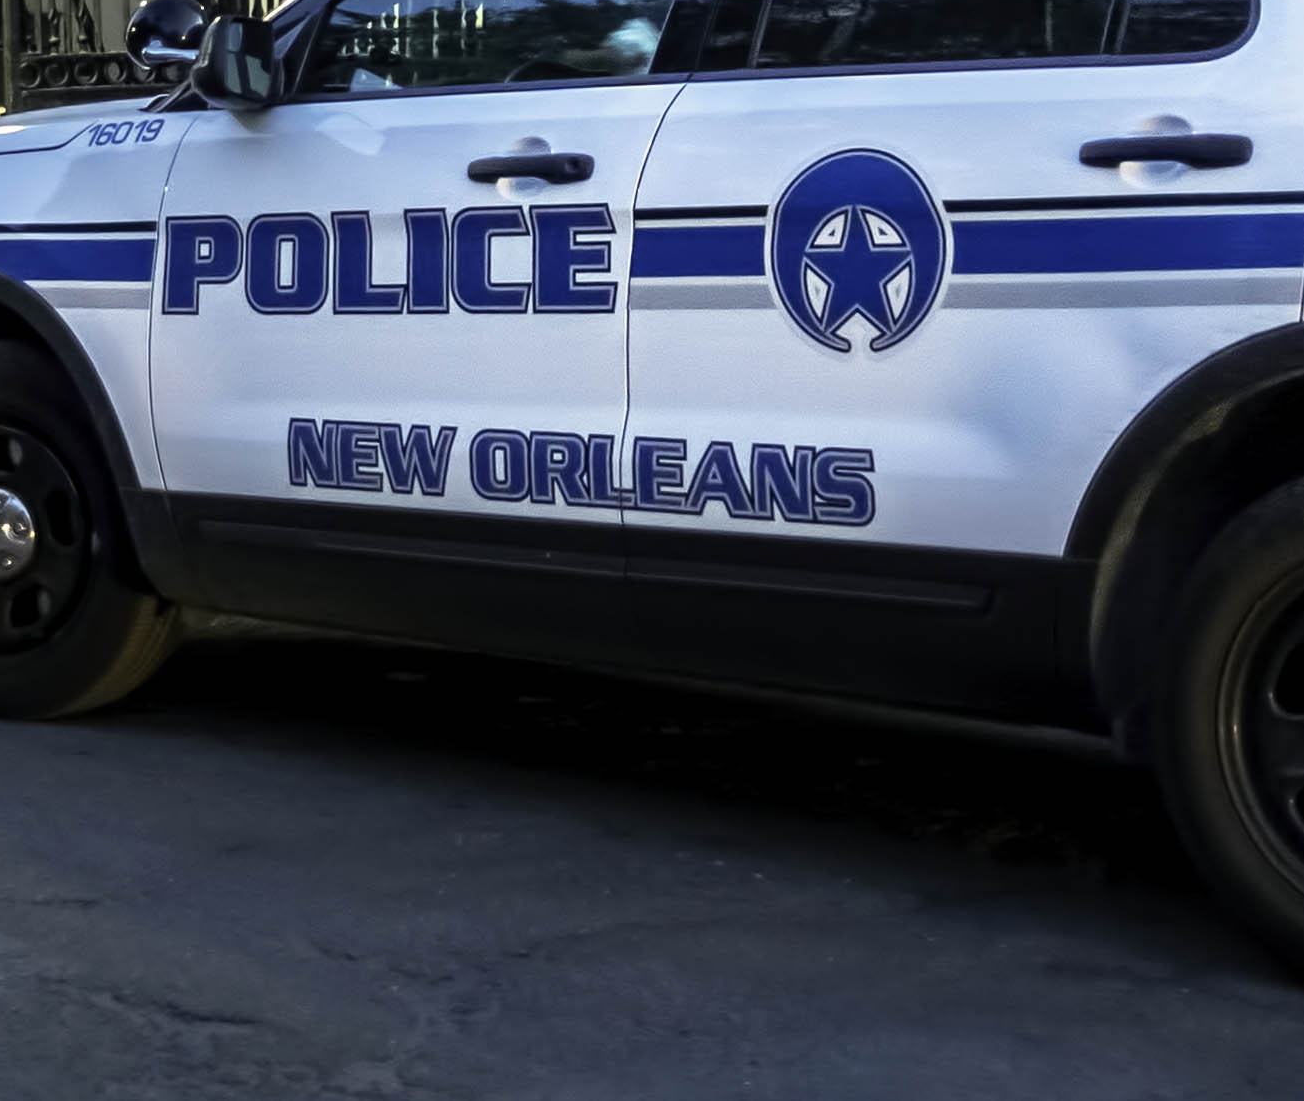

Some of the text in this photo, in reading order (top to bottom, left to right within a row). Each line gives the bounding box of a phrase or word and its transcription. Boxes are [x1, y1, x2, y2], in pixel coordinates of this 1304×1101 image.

[86, 118, 165, 148] 16019
[161, 202, 617, 315] POLICE
[288, 417, 876, 527] NEW ORLEANS
